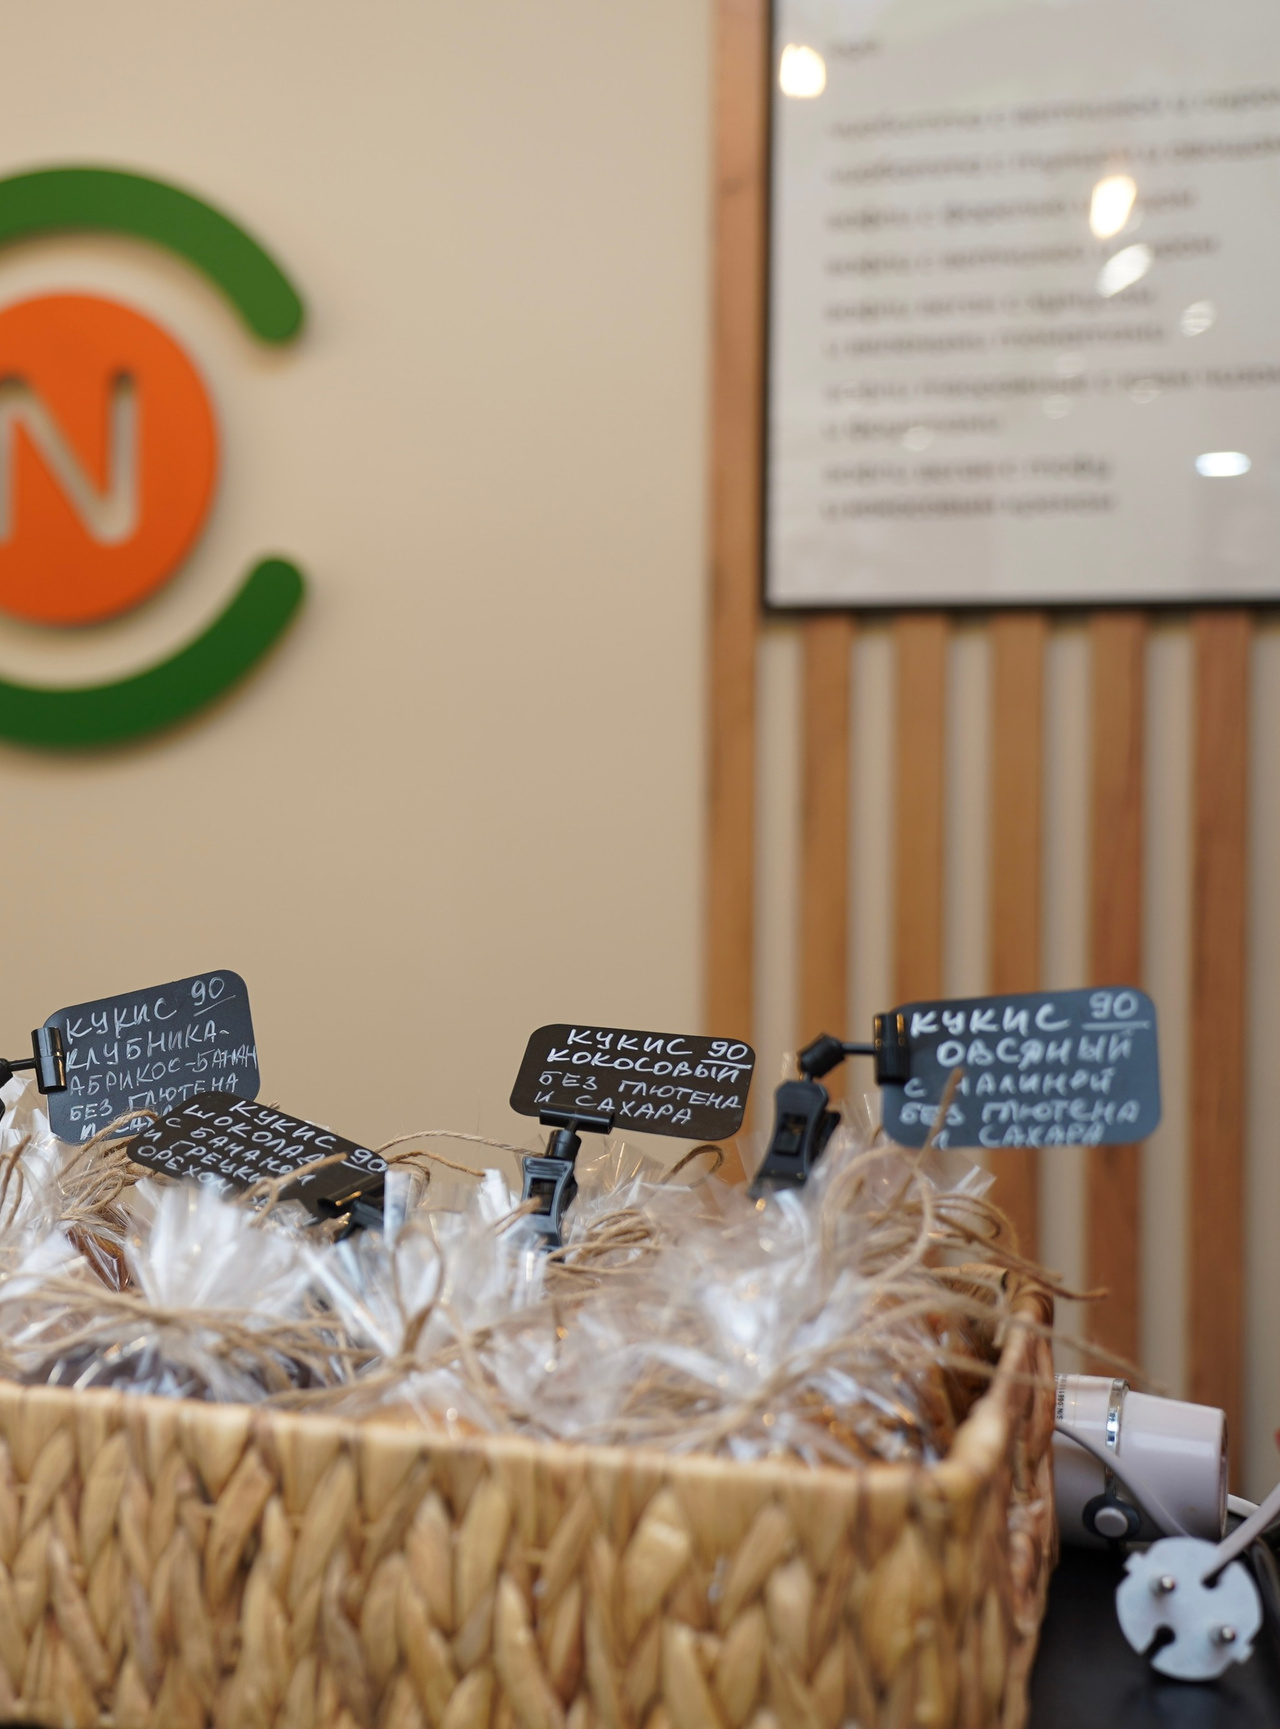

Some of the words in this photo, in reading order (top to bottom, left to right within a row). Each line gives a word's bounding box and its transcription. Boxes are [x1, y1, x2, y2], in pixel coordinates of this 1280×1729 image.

[66, 997, 177, 1045] КУКИС
[190, 976, 225, 1006] 90
[910, 1003, 1071, 1038] КУКИС
[1088, 991, 1139, 1019] 90
[566, 1029, 693, 1055] КУКИС
[707, 1041, 749, 1061] 90
[70, 1098, 113, 1122] БЕЗ
[127, 1072, 239, 1111] ГЛЮТЕНА
[538, 1071, 598, 1090] БЕЗ
[618, 1080, 742, 1109] ГЛЮТЕНА
[904, 1077, 927, 1098] С
[165, 1117, 181, 1128] С
[575, 1095, 692, 1125] САХАРА
[981, 1098, 1141, 1126] ГЛЮТЕНА
[144, 1128, 162, 1142] И
[229, 1100, 337, 1149] КУКИС
[349, 1148, 389, 1174] 90
[978, 1122, 1105, 1149] САХАРА
